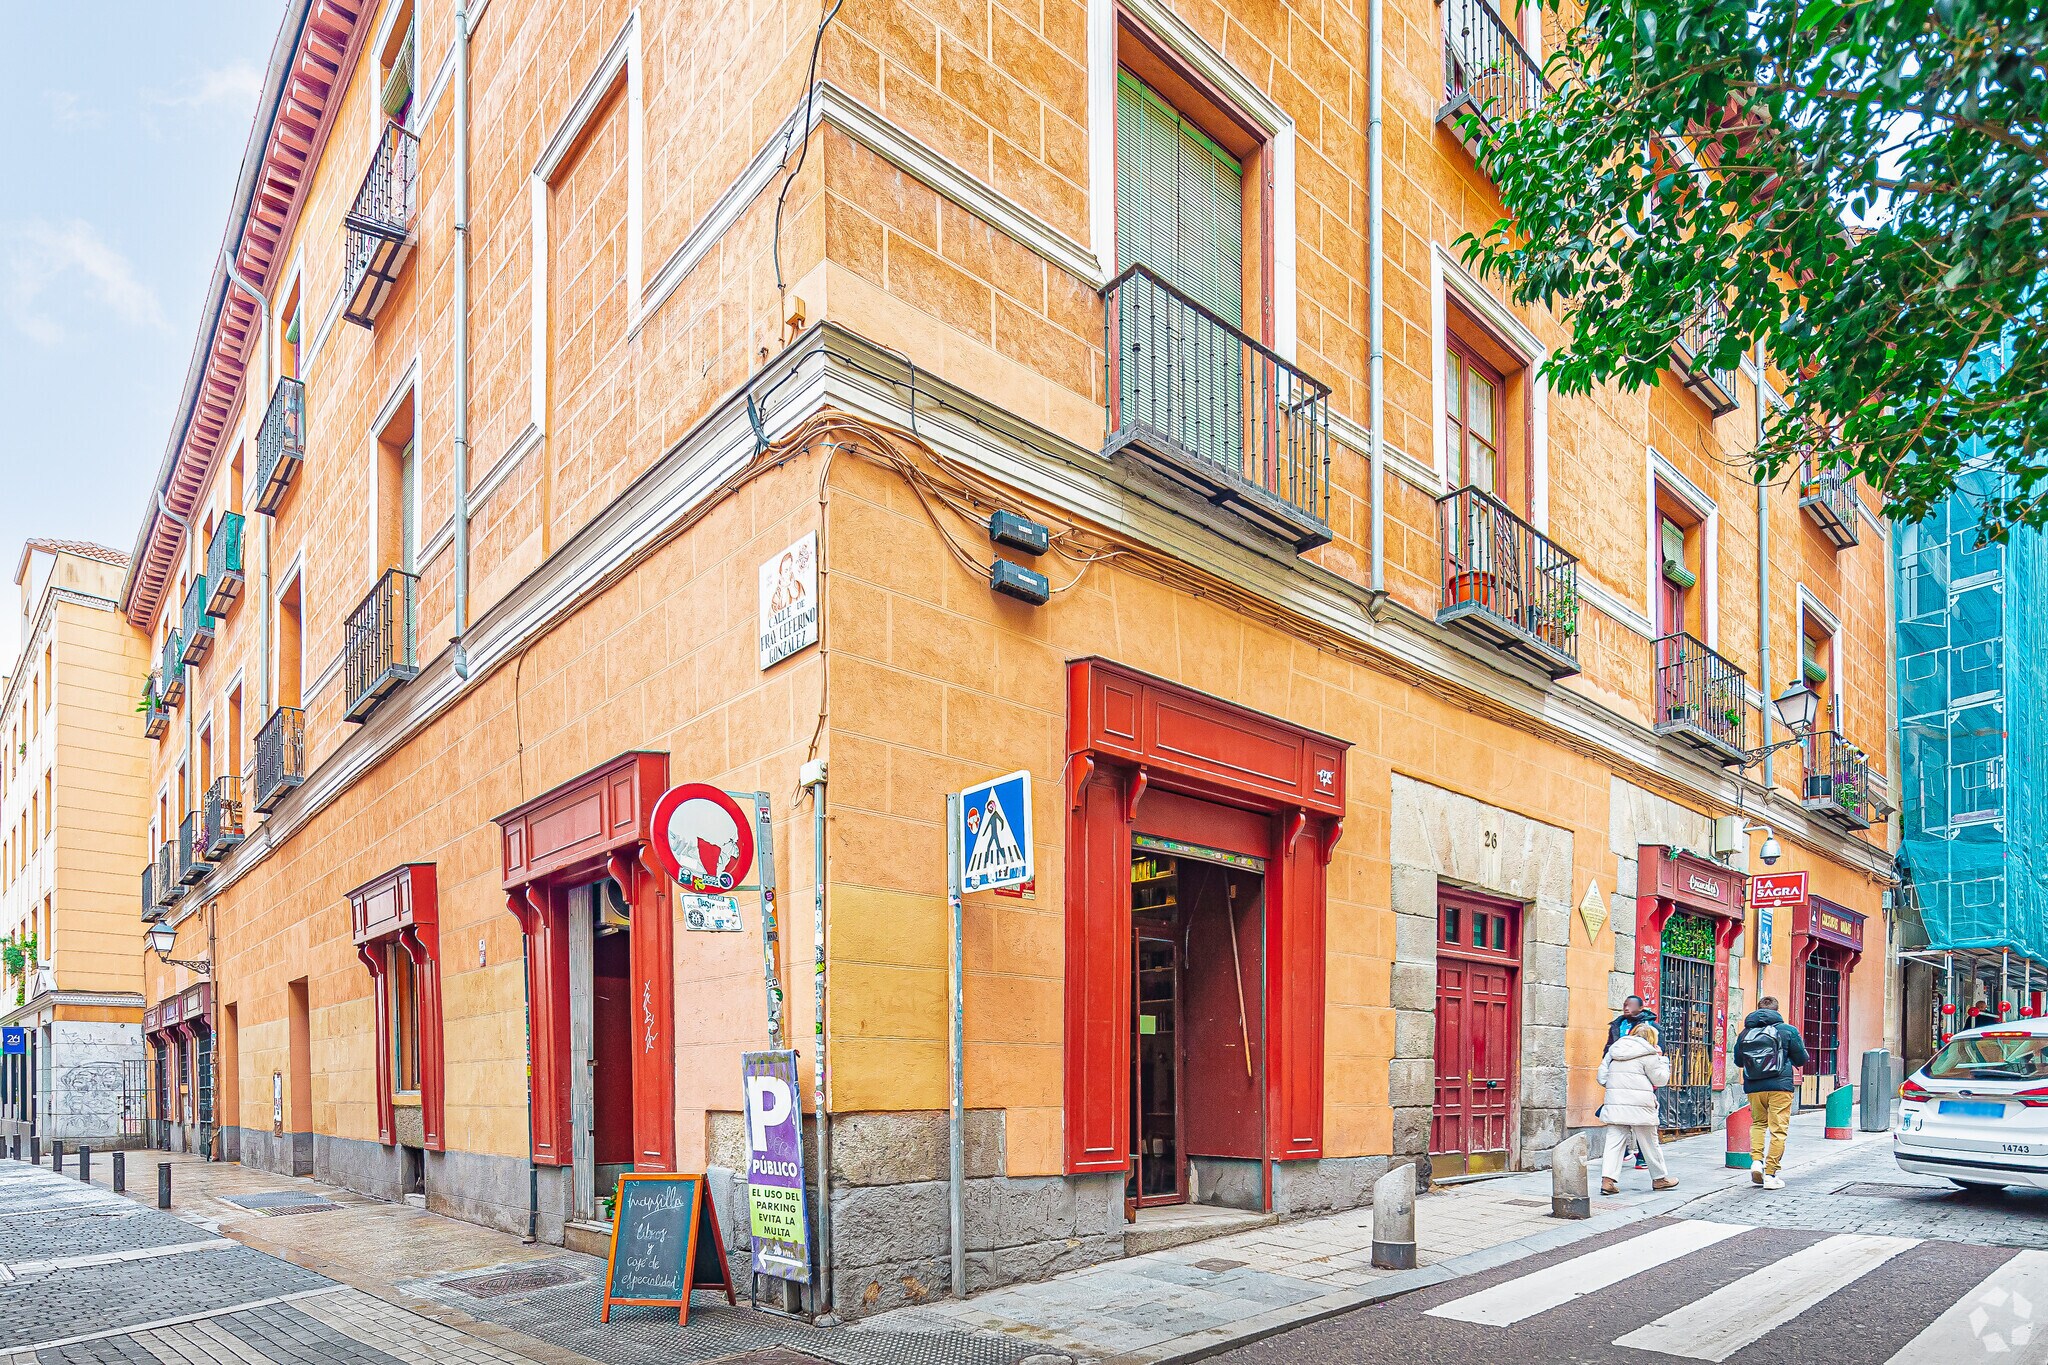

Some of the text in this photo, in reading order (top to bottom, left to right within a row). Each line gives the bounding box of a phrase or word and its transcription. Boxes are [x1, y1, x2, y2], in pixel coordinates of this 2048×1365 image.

[769, 599, 805, 628] CALLE DE
[760, 607, 816, 651] FRAY CEFERINO
[1484, 830, 1498, 849] 26
[1757, 880, 1773, 888] LA
[1757, 886, 1800, 897] SAGRA
[747, 1076, 793, 1151] P
[2002, 1144, 2029, 1153] 14743
[752, 1158, 798, 1178] PÚBLICO
[752, 1188, 800, 1201] EL USO DEL
[756, 1201, 796, 1213] PARKING
[759, 1213, 795, 1225] EVITA LA
[764, 1226, 790, 1237] MULTA
